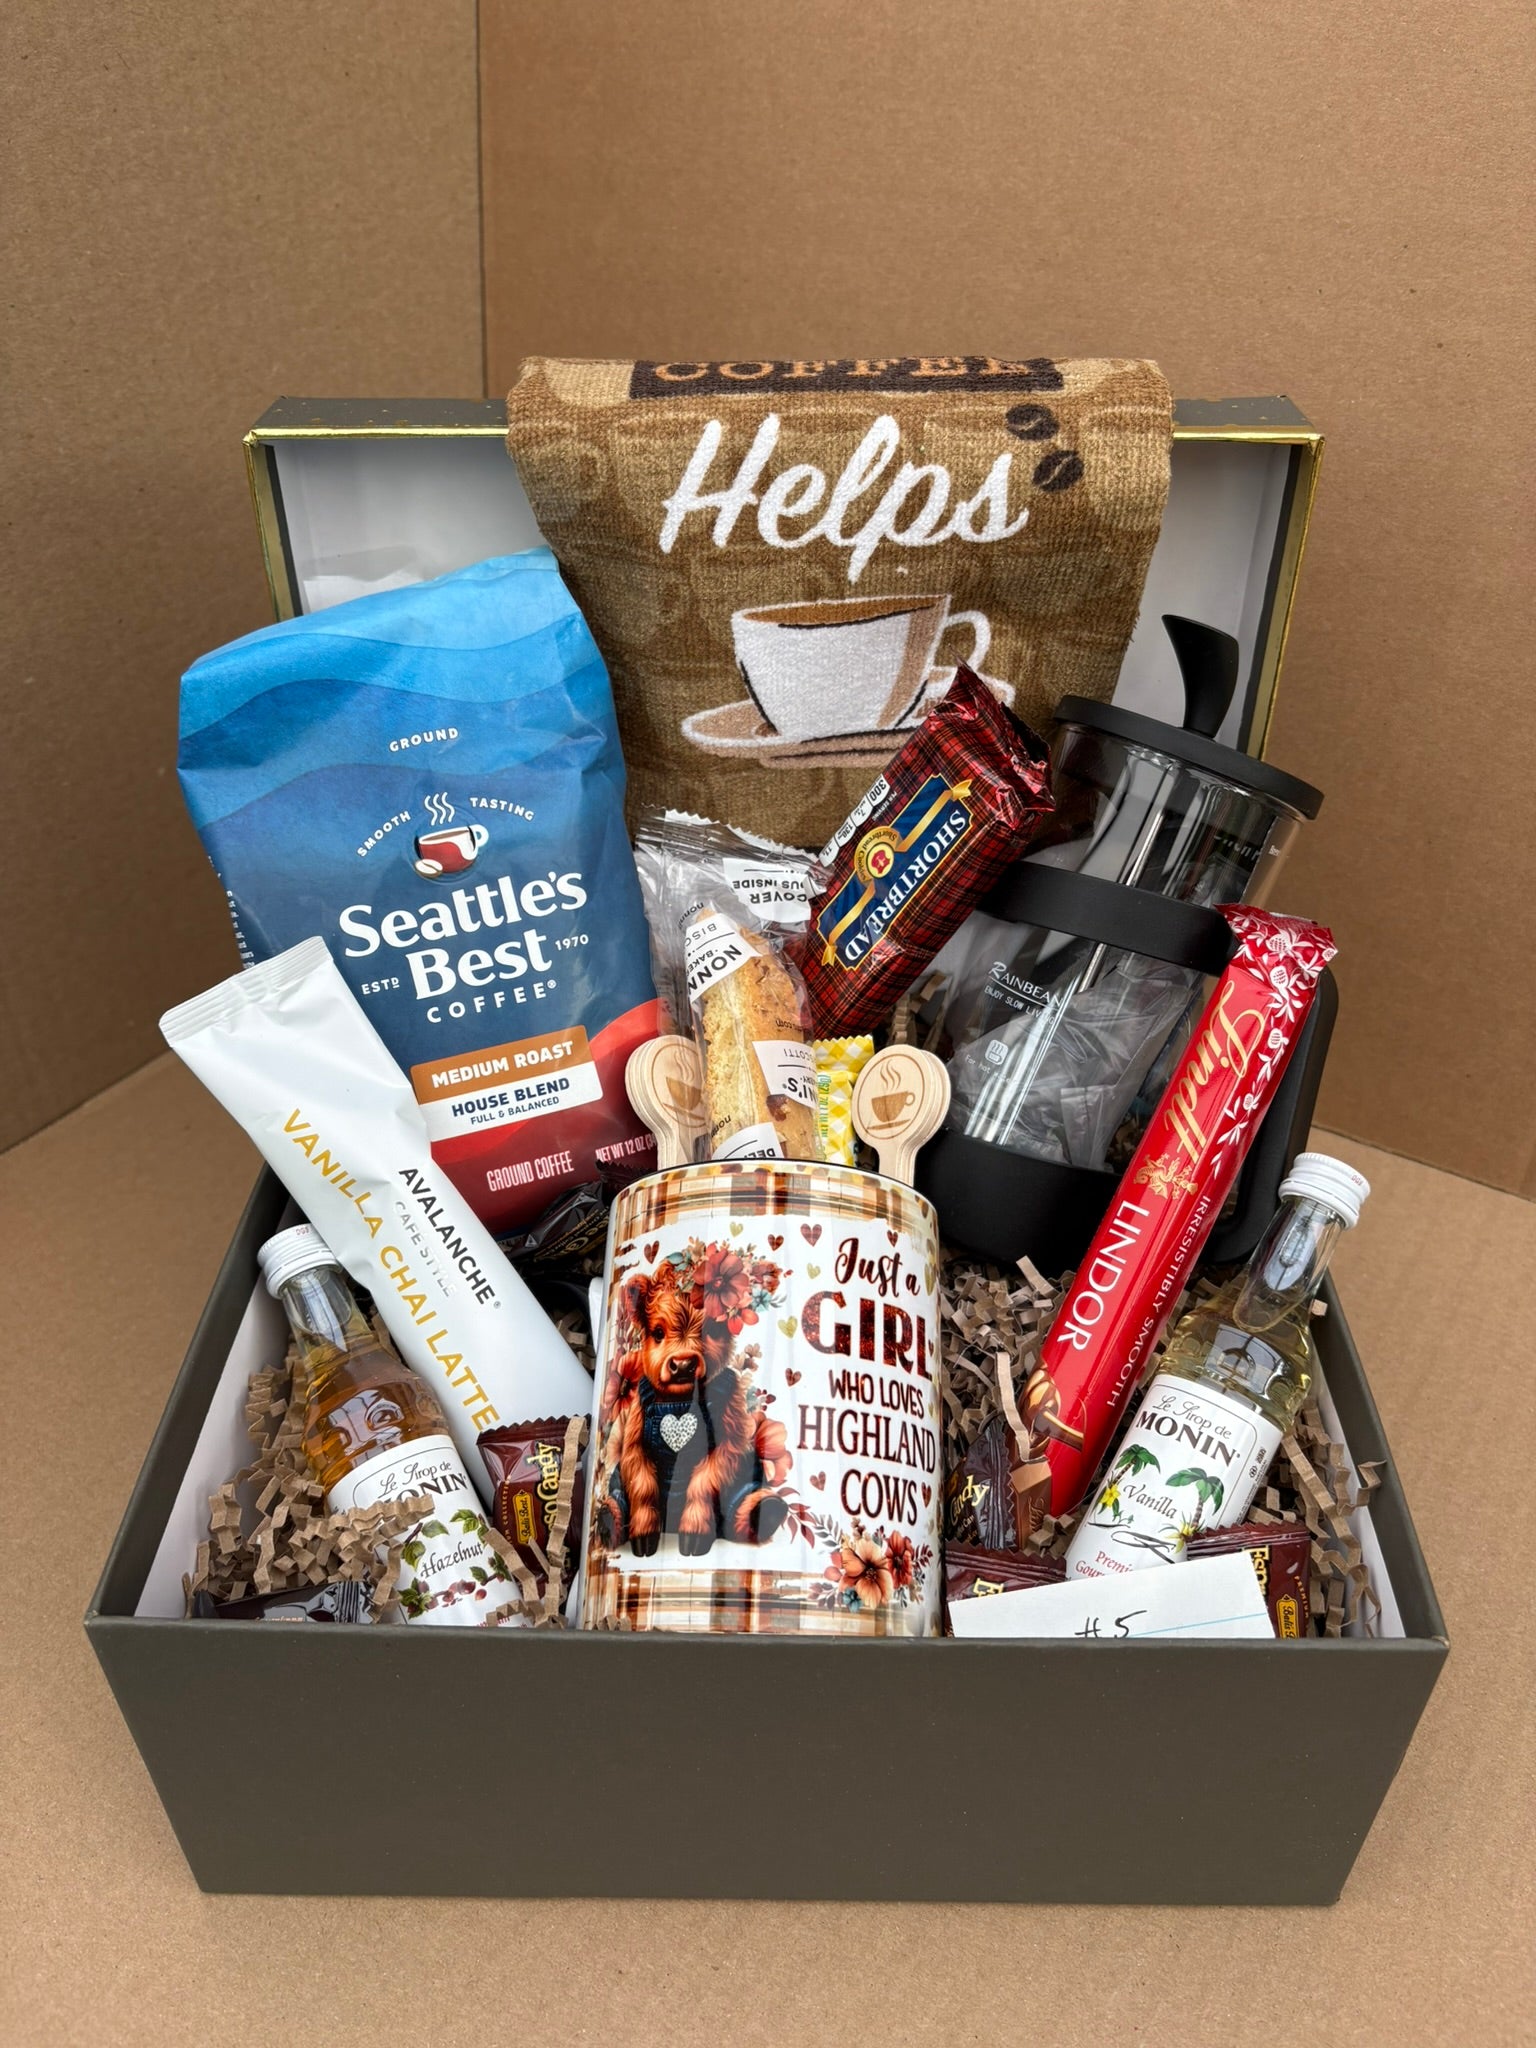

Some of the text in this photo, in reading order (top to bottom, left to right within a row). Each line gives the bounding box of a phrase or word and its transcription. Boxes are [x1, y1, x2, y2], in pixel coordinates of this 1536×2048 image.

[658, 412, 1031, 585] Helps
[389, 727, 459, 752] GROUND
[469, 797, 535, 821] TASTING
[869, 778, 887, 802] 300
[357, 810, 412, 857] SMOOTH
[732, 878, 778, 889] INSIDE
[844, 809, 967, 961] SHORTBREAD
[338, 871, 588, 957] Seattle's
[405, 928, 553, 1000] Best
[555, 934, 589, 951] 1970
[988, 961, 1064, 1008] RAINBEAN
[431, 1041, 574, 1089] MEDIUM ROAST
[1164, 978, 1266, 1165] Lindt
[451, 1077, 570, 1117] HOUSE BLEND
[470, 1096, 560, 1125] FULL & BALANCED
[486, 1150, 575, 1192] GROUND COFFEE
[595, 1147, 612, 1163] NET
[611, 1143, 625, 1160] WT
[624, 1140, 636, 1156] 12
[634, 1137, 645, 1154] OZ
[283, 1108, 501, 1432] VANILLA CHAI LATTE
[834, 1237, 921, 1299] Just a
[1058, 1199, 1150, 1352] LINDOR
[1105, 1195, 1212, 1408] IRRESISTIBLY SMOOTH
[800, 1290, 933, 1381] GIRL
[828, 1369, 925, 1420] WHO LOVES
[796, 1404, 937, 1475] HIGHLAND
[1135, 1410, 1241, 1468] MONIN
[1172, 1401, 1213, 1434] Sirop
[1214, 1425, 1233, 1440] de
[383, 1472, 469, 1503] ONIN
[402, 1462, 438, 1486] Sirop
[439, 1461, 452, 1471] de
[840, 1468, 919, 1527] COWS
[1122, 1484, 1178, 1519] Vanilla
[420, 1541, 484, 1579] Hazelnut
